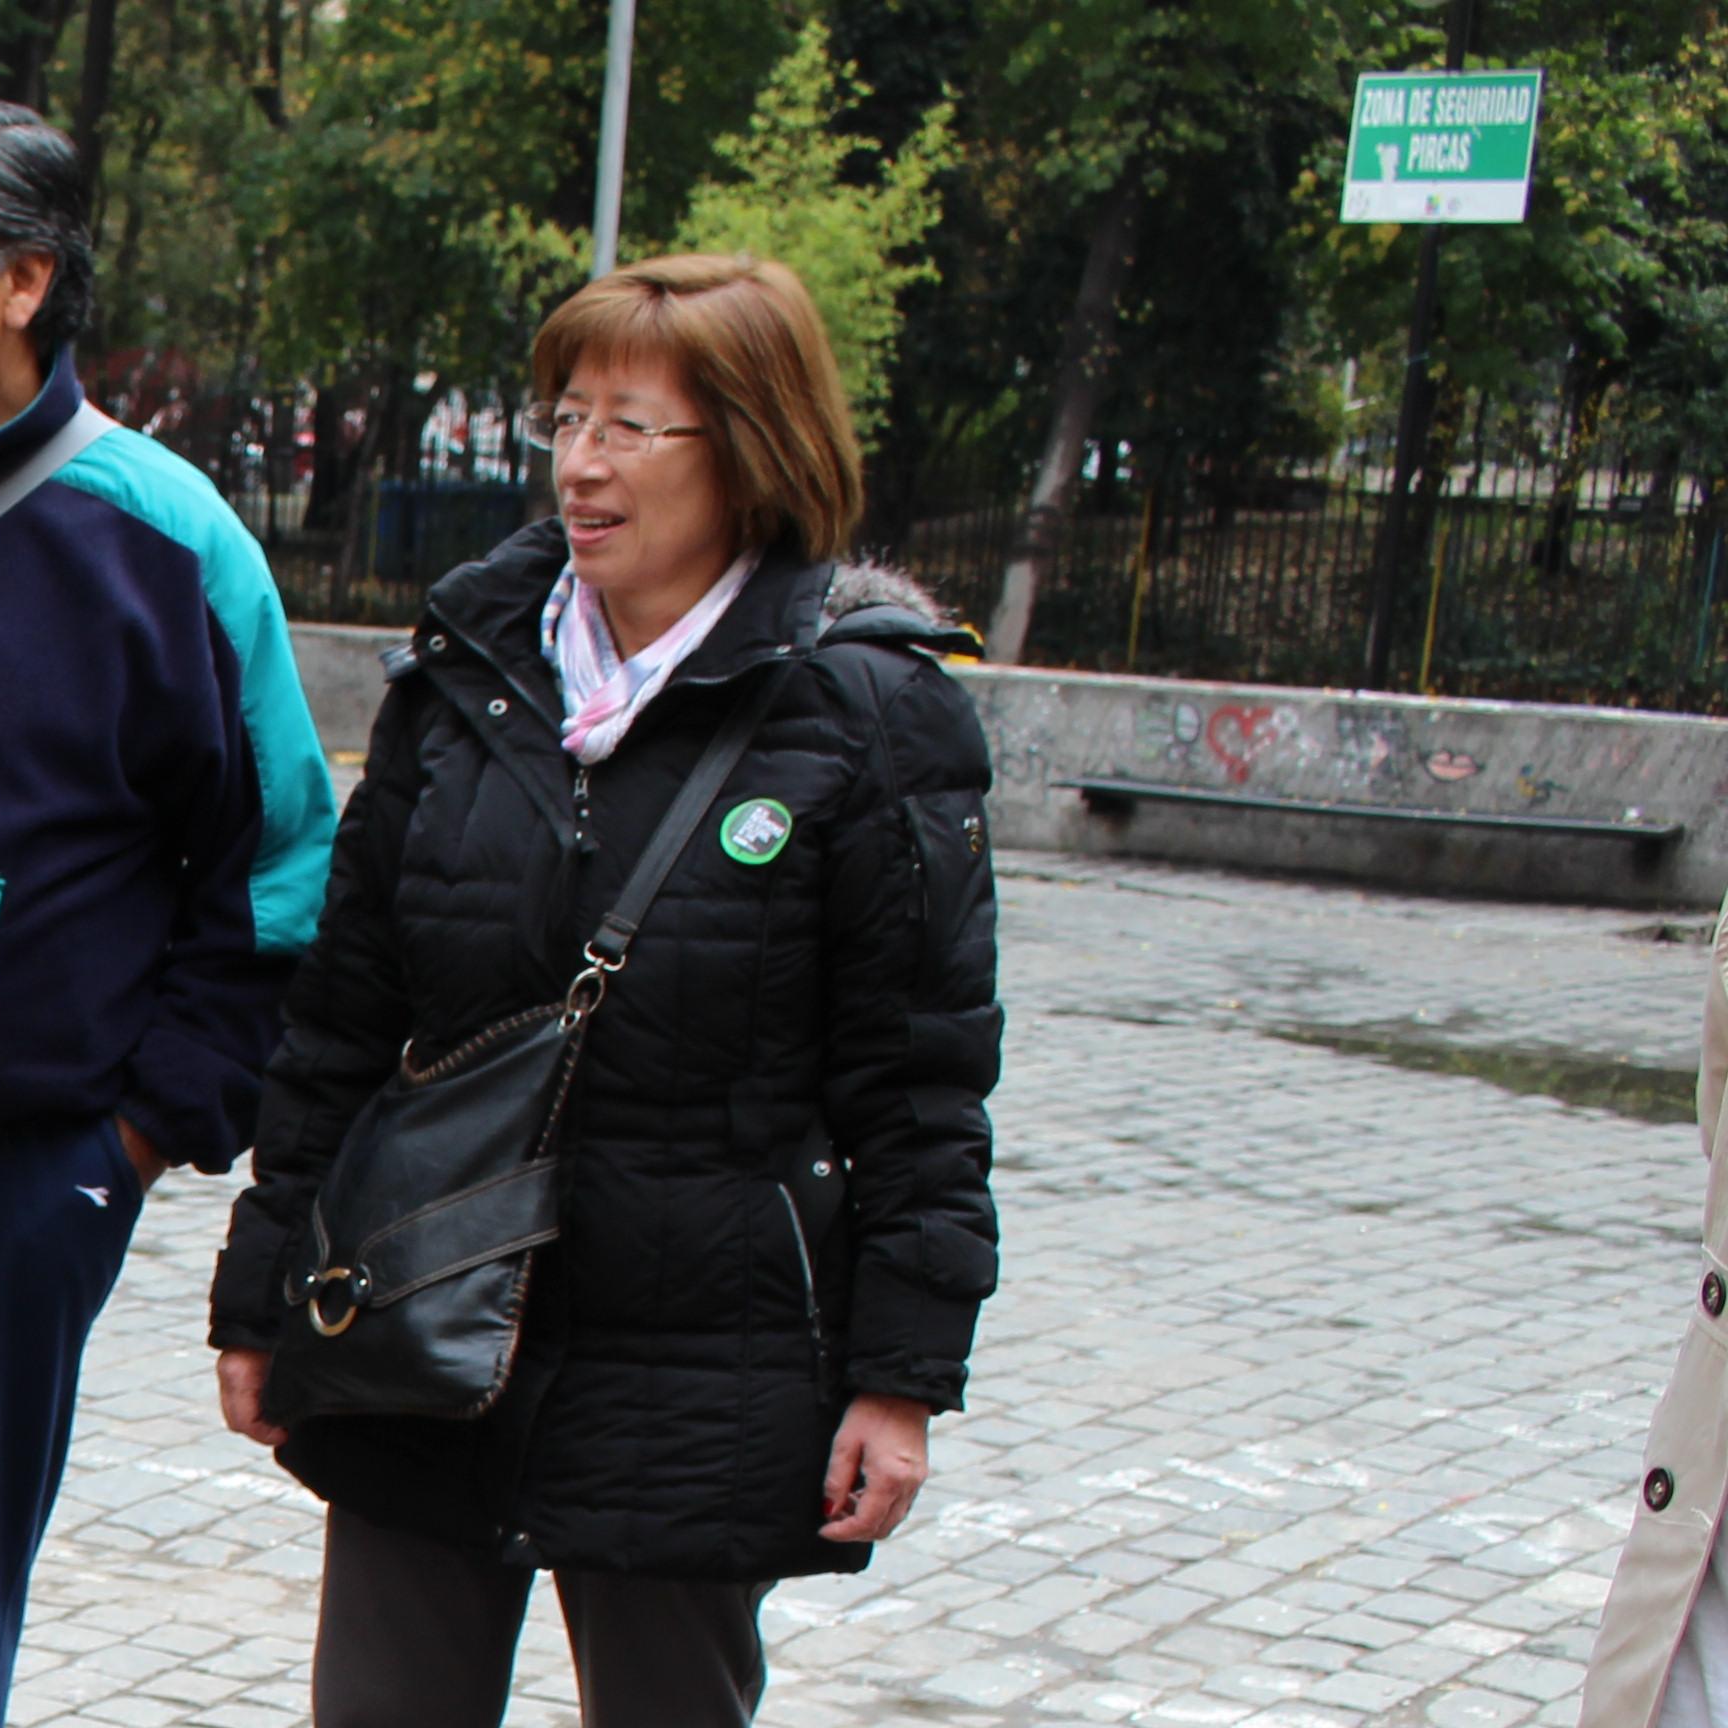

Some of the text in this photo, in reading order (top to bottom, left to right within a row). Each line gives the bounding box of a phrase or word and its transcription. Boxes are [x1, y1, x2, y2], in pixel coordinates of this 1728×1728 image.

[1360, 85, 1531, 127] ZONA DE SEGURIDAD
[1406, 132, 1471, 173] PIRCAS
